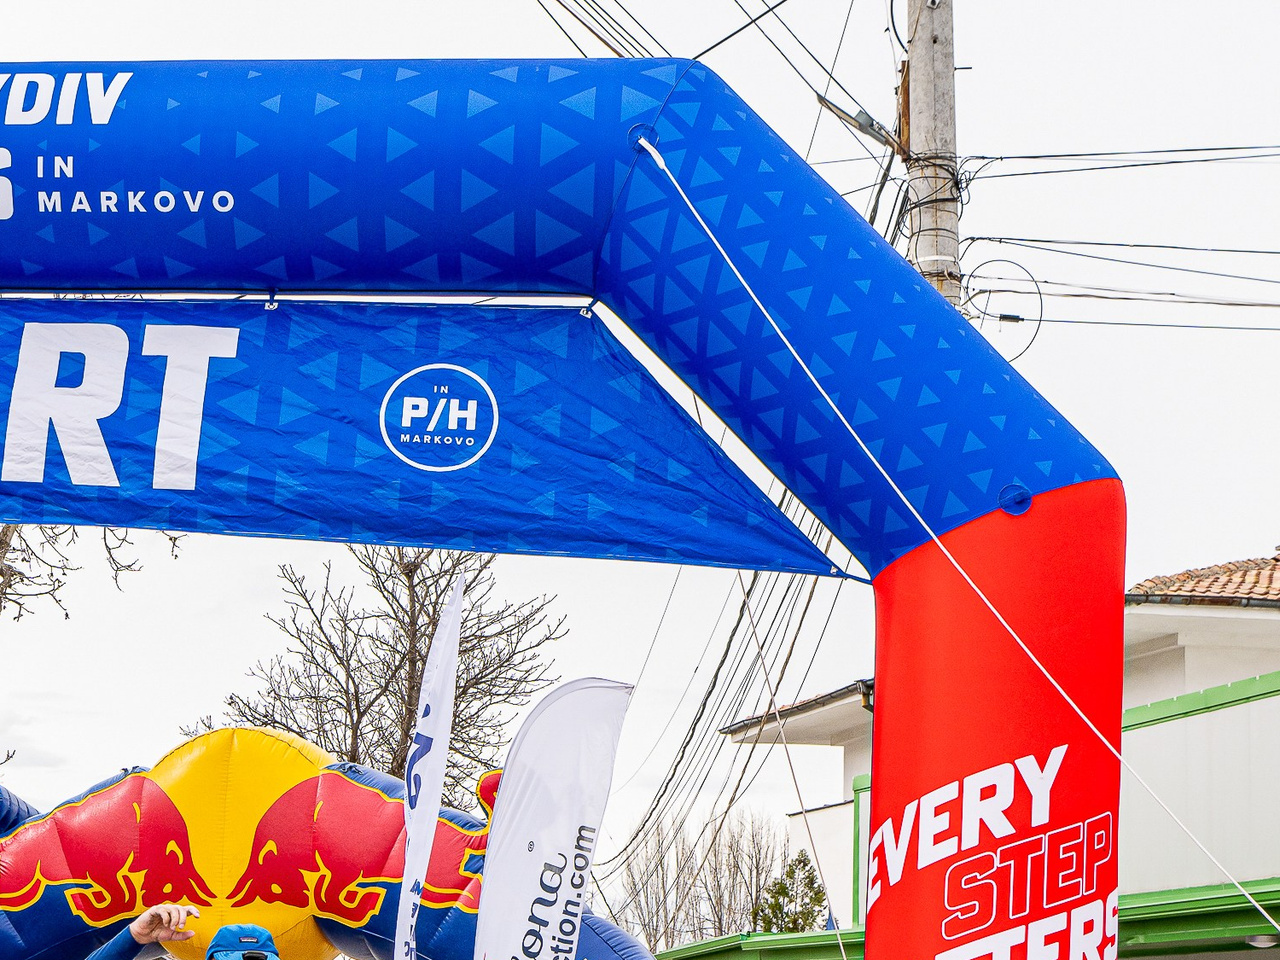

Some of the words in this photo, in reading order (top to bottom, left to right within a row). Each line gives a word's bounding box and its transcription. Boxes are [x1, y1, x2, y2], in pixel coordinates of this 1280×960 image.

[37, 156, 73, 178] IN
[38, 190, 235, 213] MARKOVO
[434, 385, 448, 393] IN
[402, 397, 476, 432] P/H
[400, 434, 476, 445] MARKOVO
[868, 744, 1068, 914] EVERY
[942, 812, 1112, 941] STEP
